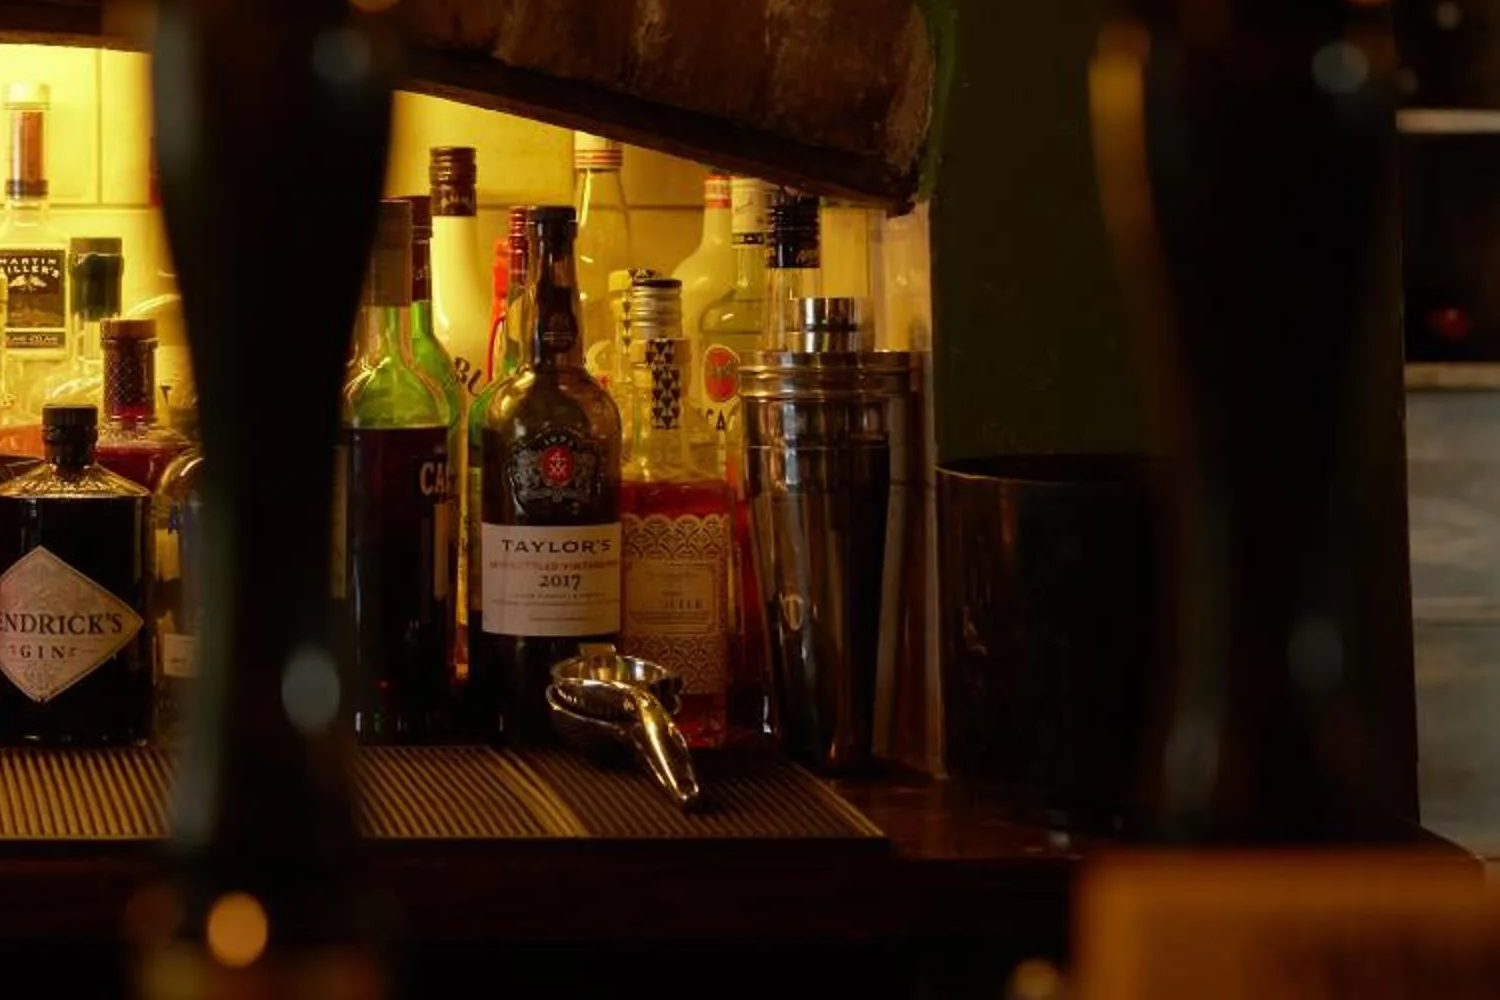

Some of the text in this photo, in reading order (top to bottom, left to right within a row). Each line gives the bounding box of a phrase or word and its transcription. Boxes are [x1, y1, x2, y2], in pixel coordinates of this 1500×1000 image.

[502, 538, 612, 555] TAYLOR'S
[540, 574, 581, 591] 2017
[20, 646, 67, 660] GIN
